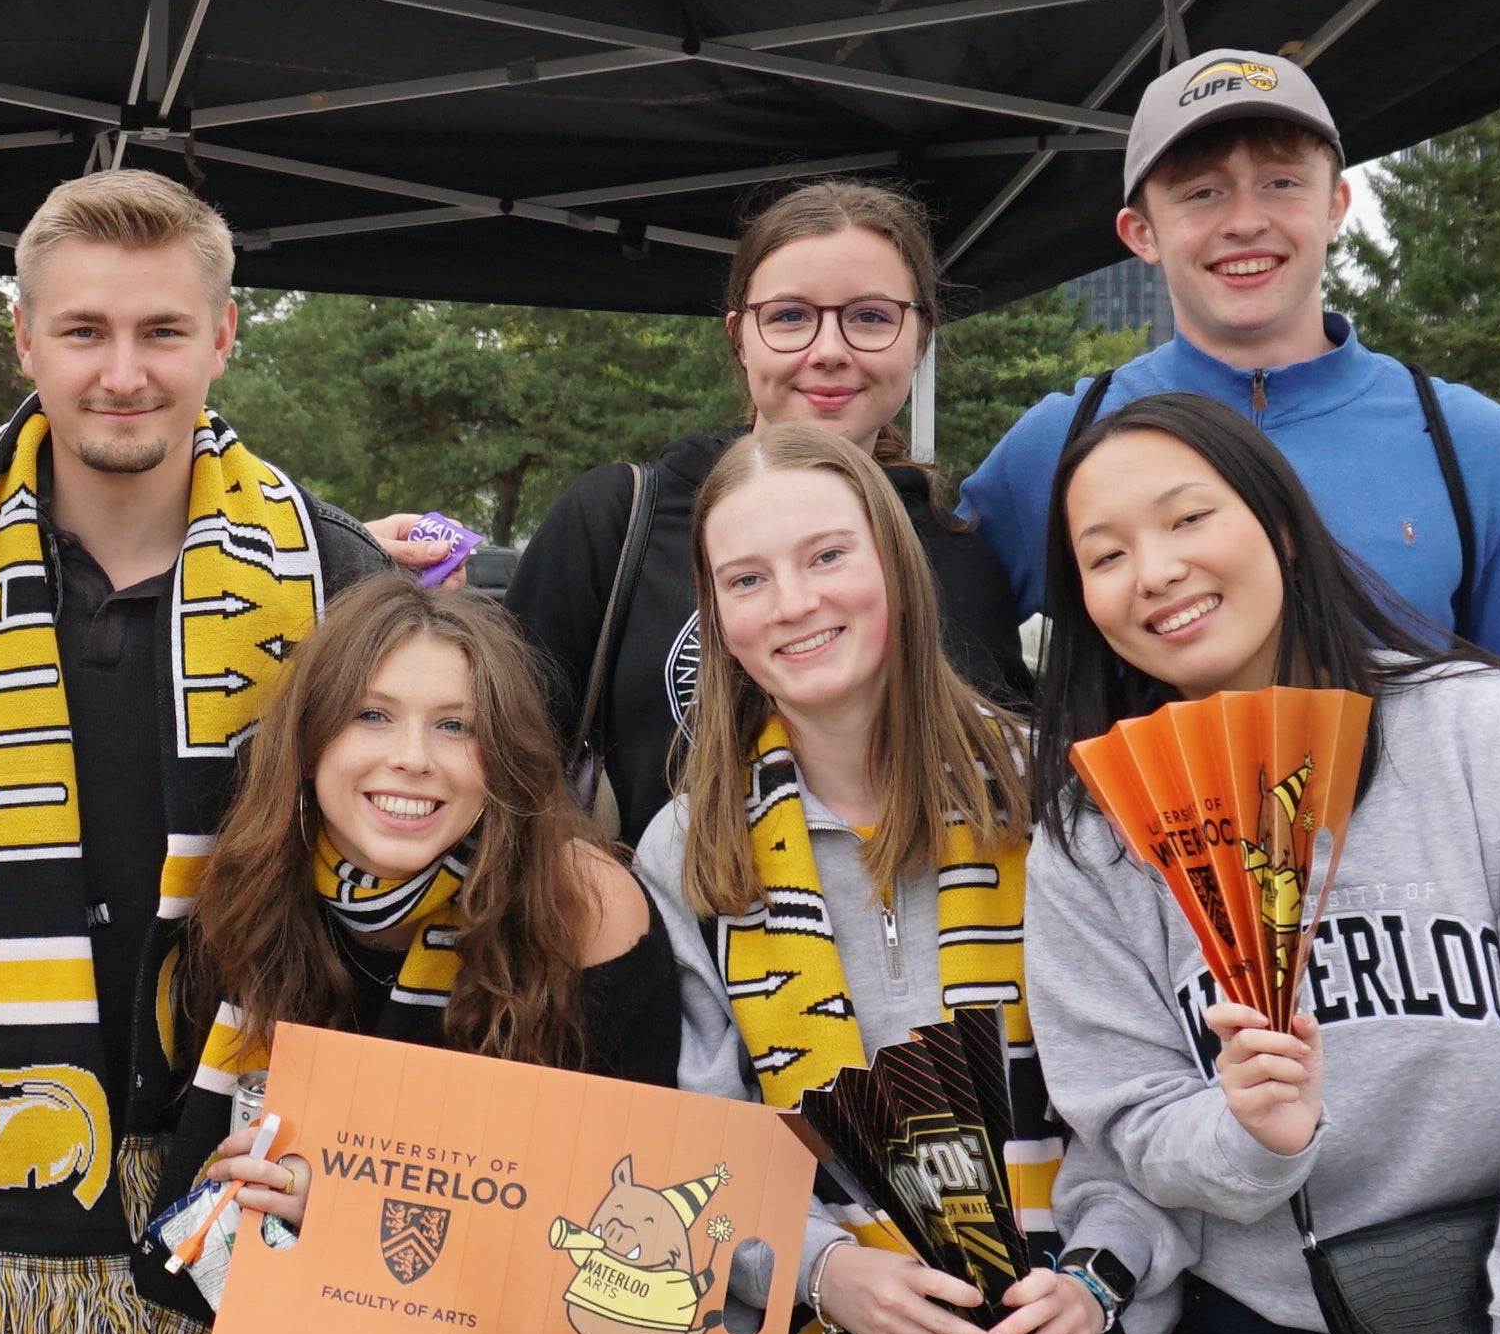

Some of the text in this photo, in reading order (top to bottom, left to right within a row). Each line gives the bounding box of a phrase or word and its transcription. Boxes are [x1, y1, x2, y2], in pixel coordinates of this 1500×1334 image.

[1178, 77, 1243, 107] CUPE
[420, 517, 464, 553] MADE
[1204, 798, 1223, 812] OF
[1406, 881, 1440, 900] OF
[336, 1130, 519, 1175] UNIVERSITY OF
[321, 1147, 528, 1211] WATERLOO
[580, 1259, 651, 1298] WATERLOO
[582, 1275, 619, 1299] ARTS
[321, 1285, 478, 1328] FACULTY OF ARTS
